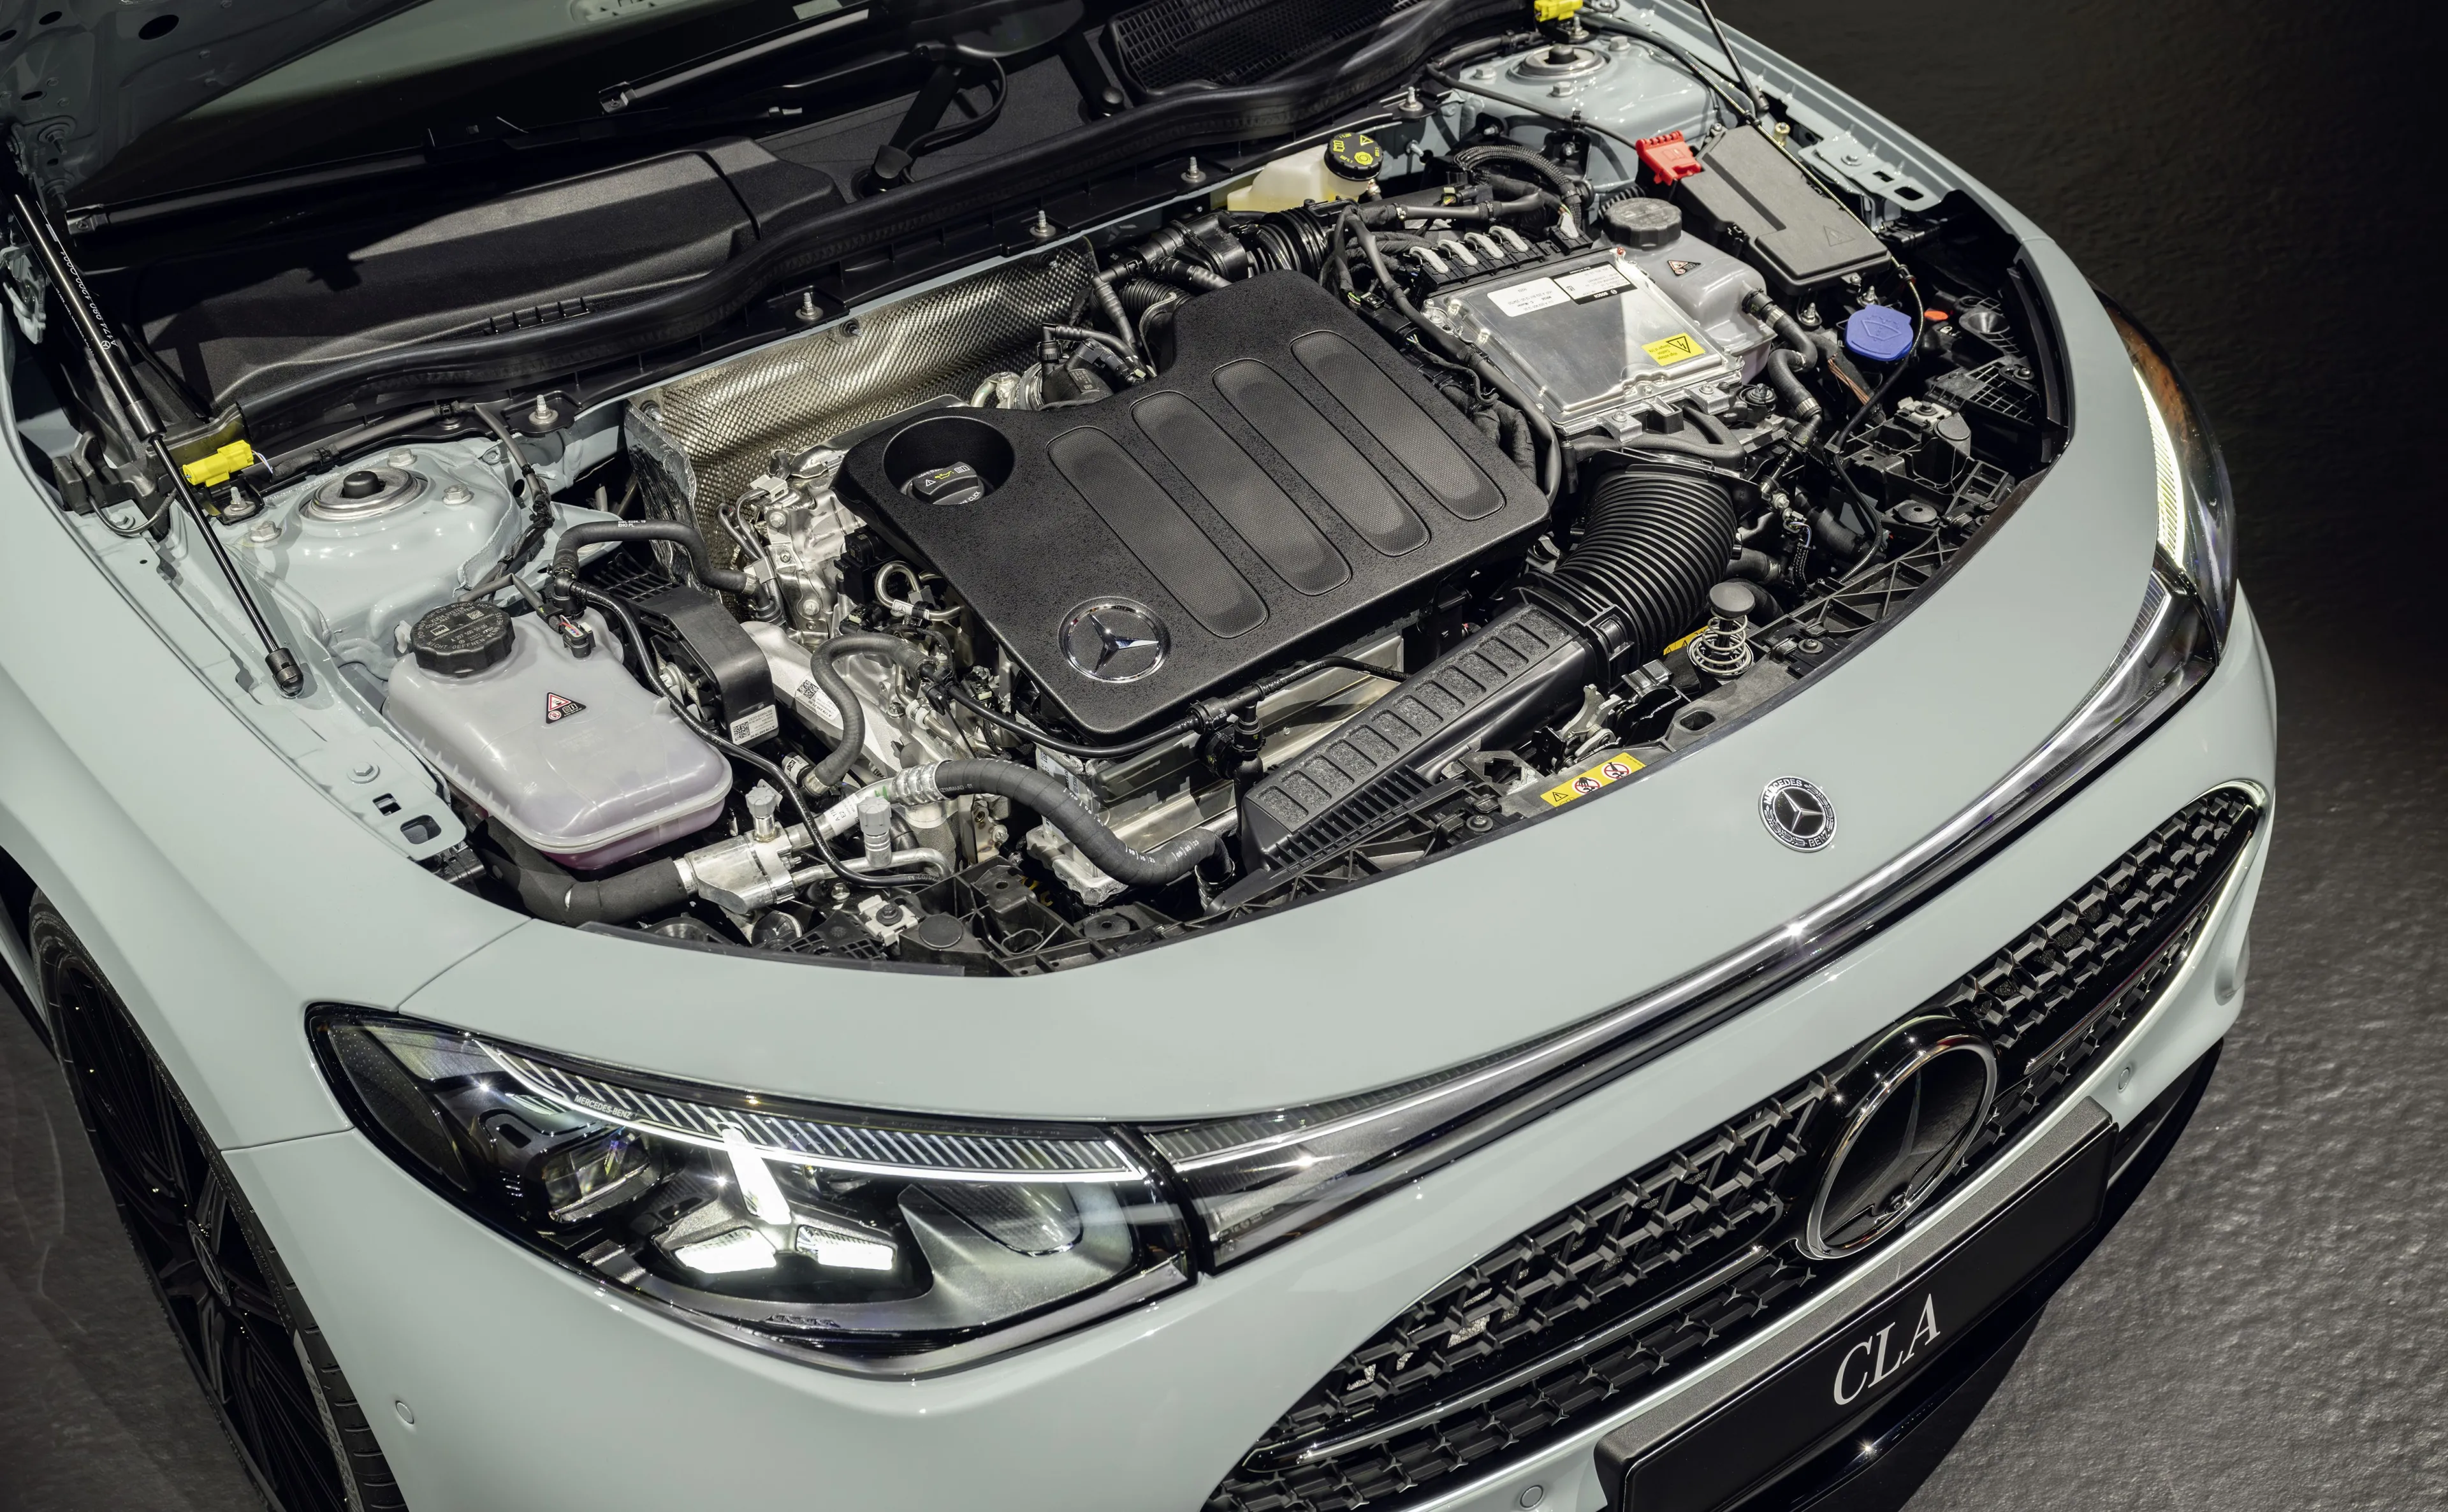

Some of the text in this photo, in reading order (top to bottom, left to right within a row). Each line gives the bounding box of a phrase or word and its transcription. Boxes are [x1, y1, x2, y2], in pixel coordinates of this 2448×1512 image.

[968, 491, 980, 501] CLICK
[418, 620, 427, 630] NOT
[427, 607, 446, 618] OPEN
[425, 616, 451, 629] COOLANT
[453, 606, 475, 617] SYSTEM
[430, 606, 465, 623] KUEHLSYSTEM
[426, 641, 448, 650] NICHT
[452, 637, 486, 650] OEFFNEN
[495, 612, 504, 625] HEISS
[1764, 779, 1829, 847] MERCEDES BENZ
[574, 1094, 632, 1119] MERCEDES-BENZ
[1833, 1293, 1941, 1406] CLA
